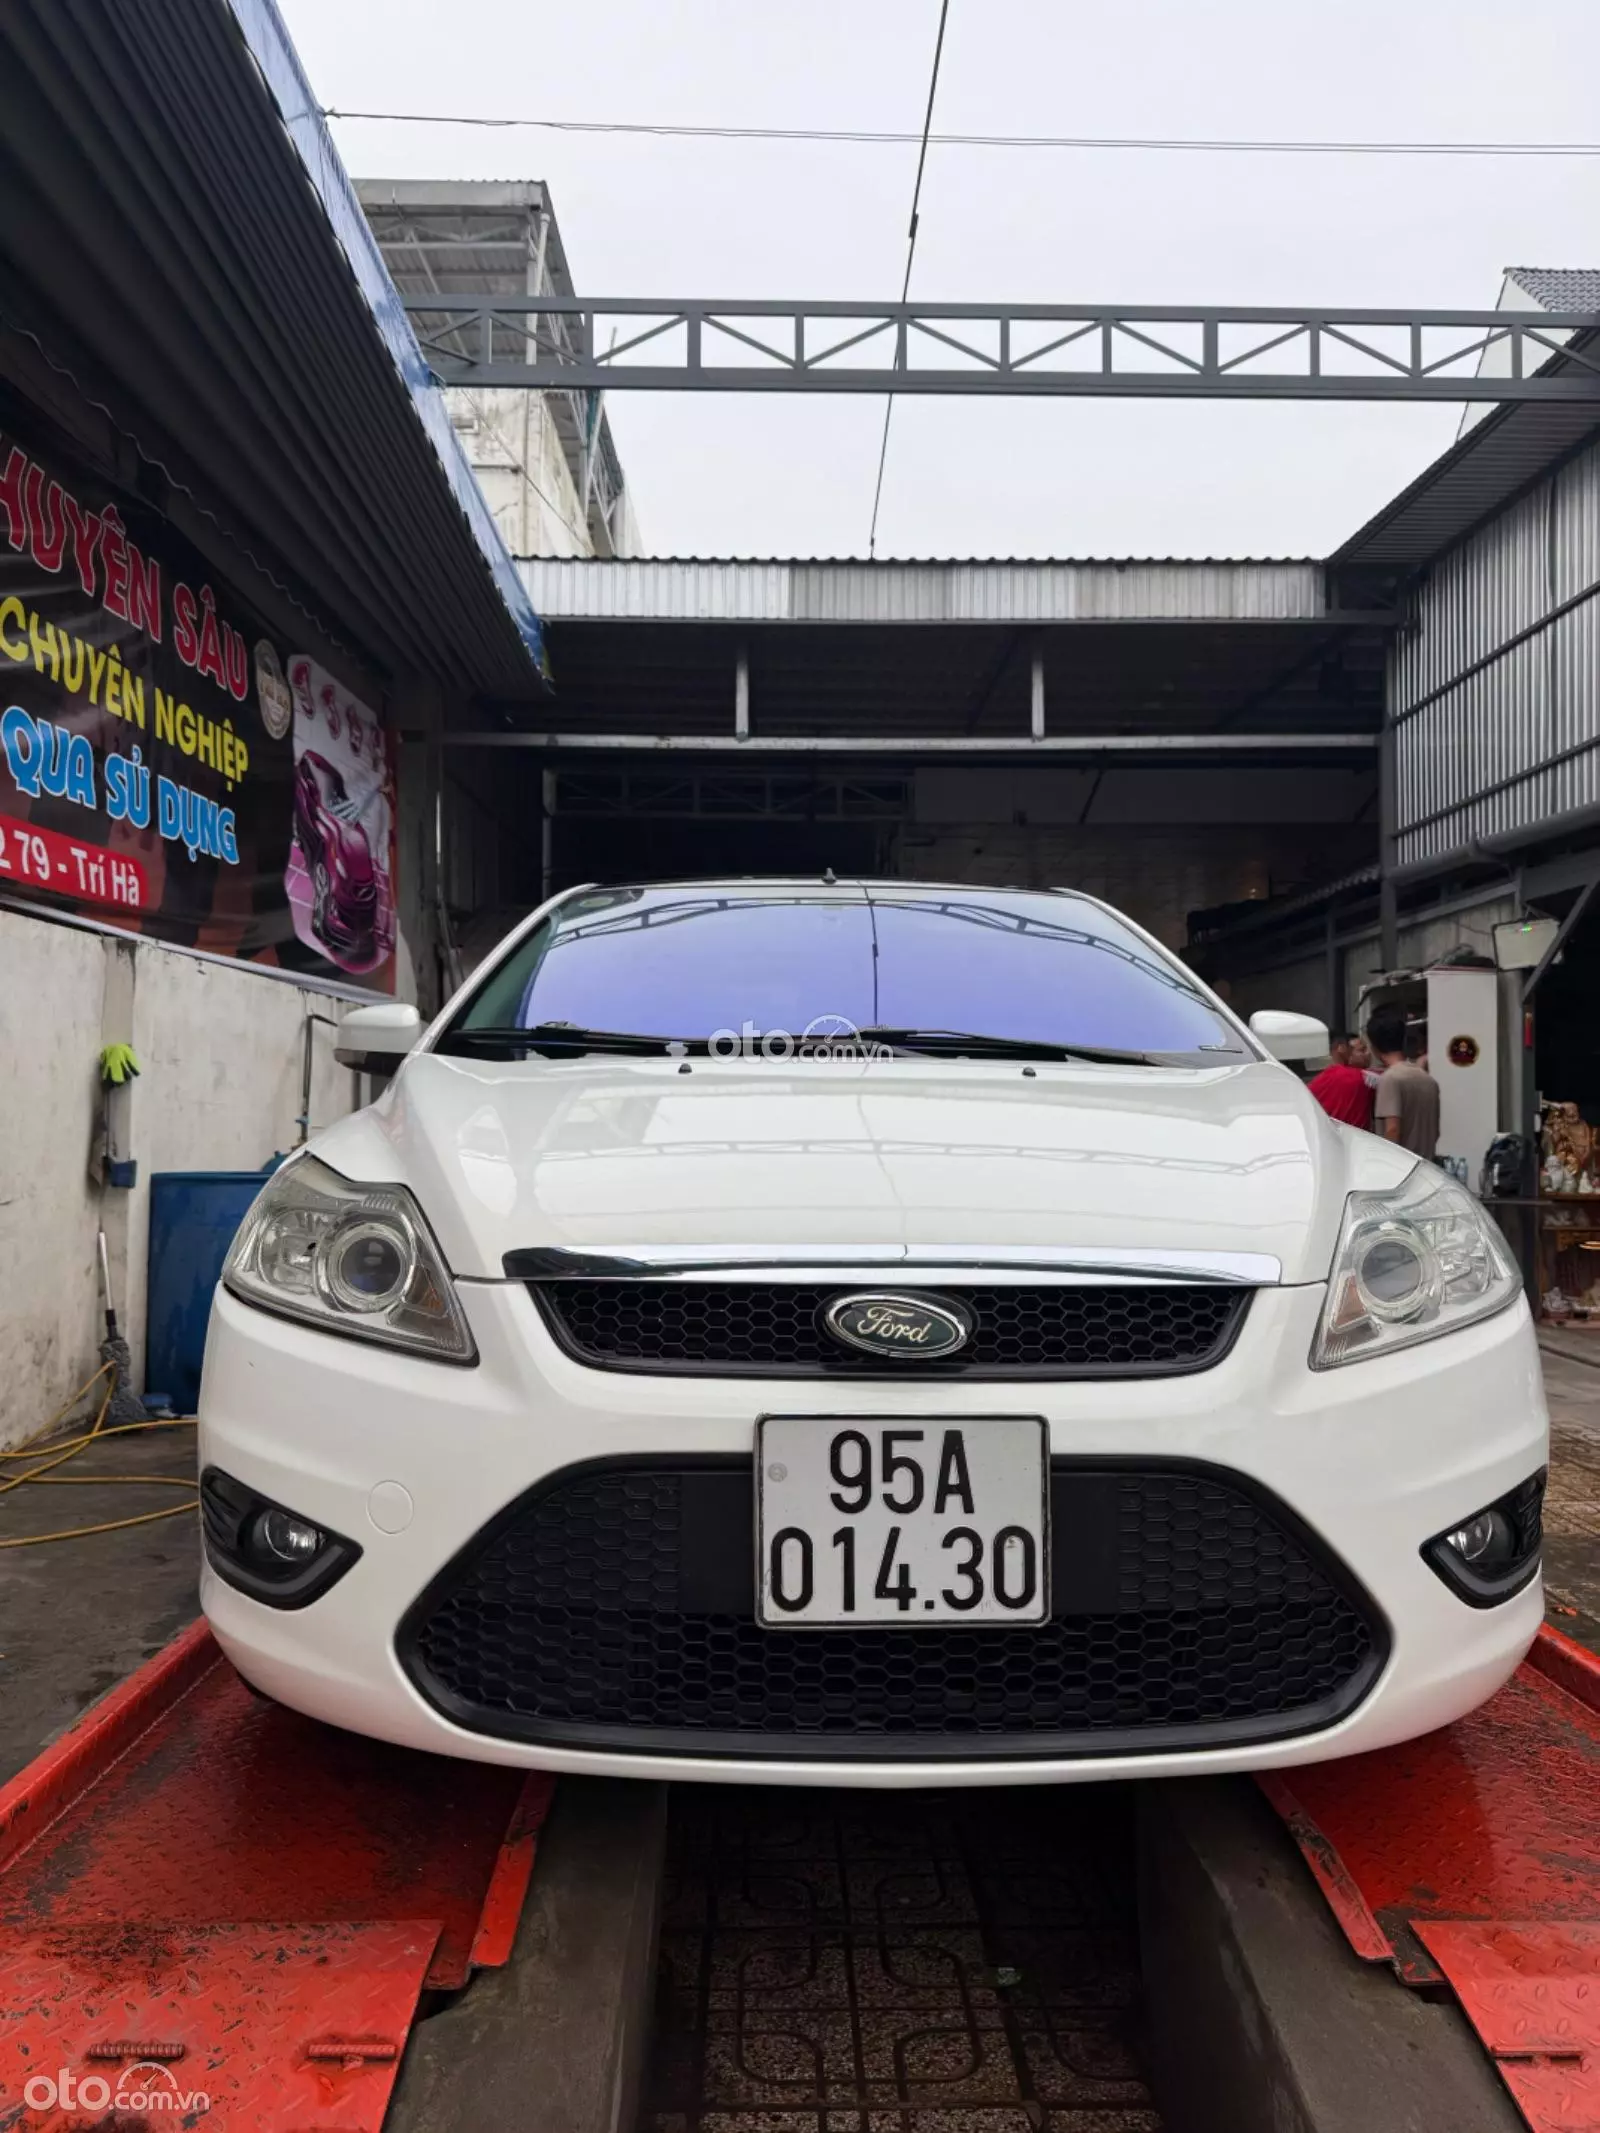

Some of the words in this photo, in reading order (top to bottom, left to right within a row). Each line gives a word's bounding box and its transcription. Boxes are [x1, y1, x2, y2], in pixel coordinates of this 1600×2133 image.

[173, 582, 249, 701] SÂU
[0, 597, 145, 730] CHUYÊN
[155, 687, 249, 792] NGHIỆP
[1, 705, 97, 810] QUA
[105, 744, 150, 829] SỬ
[158, 774, 240, 865] DỤNG
[14, 829, 50, 881] 79
[70, 846, 105, 897] Trí
[111, 859, 140, 906] Hà
[857, 1306, 932, 1344] Ford
[829, 1429, 975, 1514] 95A
[769, 1525, 1036, 1612] 014.30
